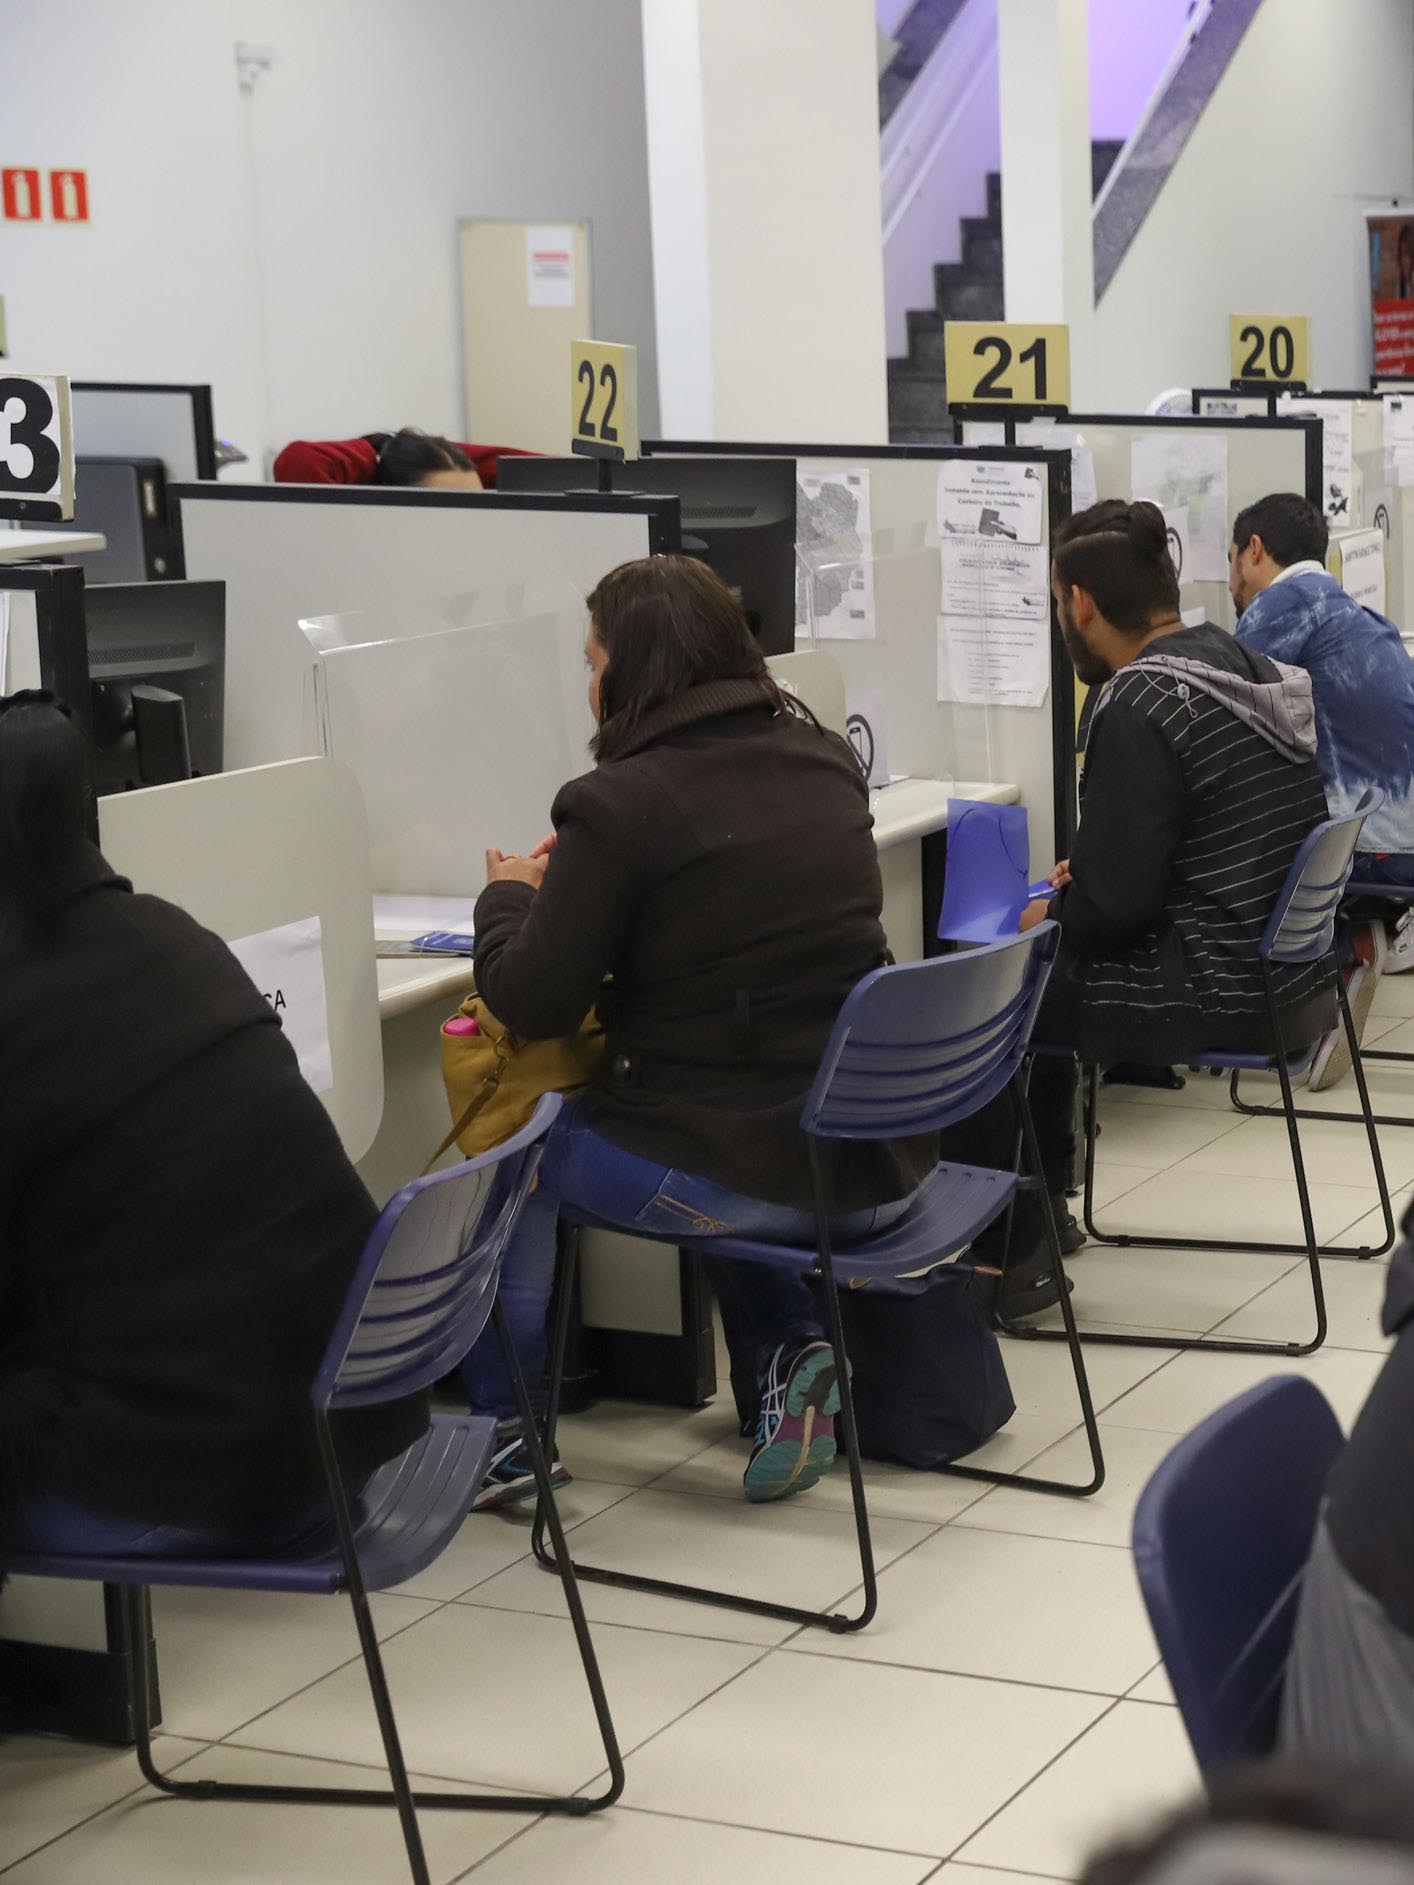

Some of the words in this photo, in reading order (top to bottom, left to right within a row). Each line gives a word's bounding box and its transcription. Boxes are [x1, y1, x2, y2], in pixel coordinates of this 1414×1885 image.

[972, 336, 1047, 401] 21
[1240, 325, 1295, 379] 20
[0, 378, 60, 494] 3
[577, 359, 618, 443] 22
